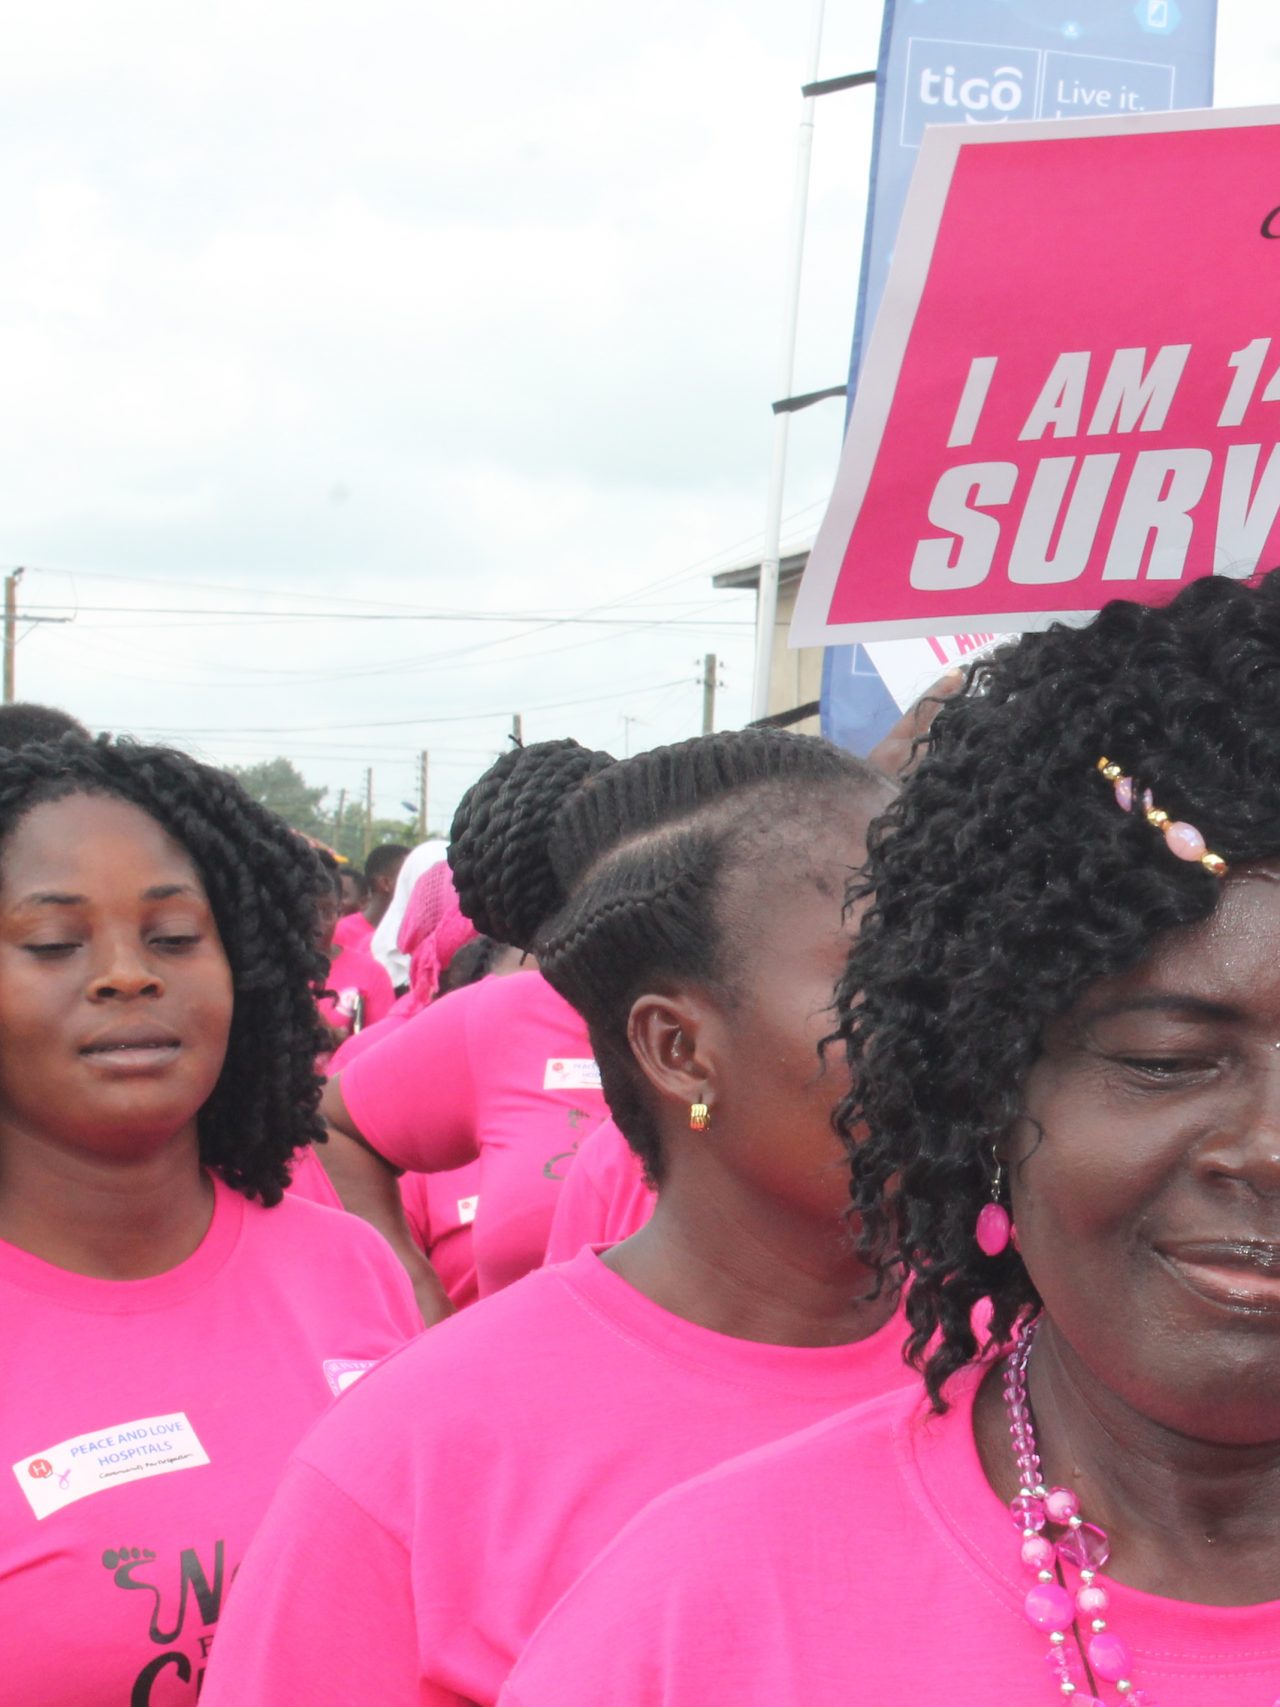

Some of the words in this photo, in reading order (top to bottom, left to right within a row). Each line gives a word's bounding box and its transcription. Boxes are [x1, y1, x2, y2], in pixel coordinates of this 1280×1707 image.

[1056, 79, 1111, 107] Live
[1119, 85, 1145, 111] it.
[947, 356, 998, 448] I
[1017, 343, 1192, 442] AM
[70, 1436, 116, 1458] PEACE
[117, 1428, 149, 1445] AND
[149, 1420, 184, 1436] LOVE
[97, 1440, 174, 1467] HOSPITALS
